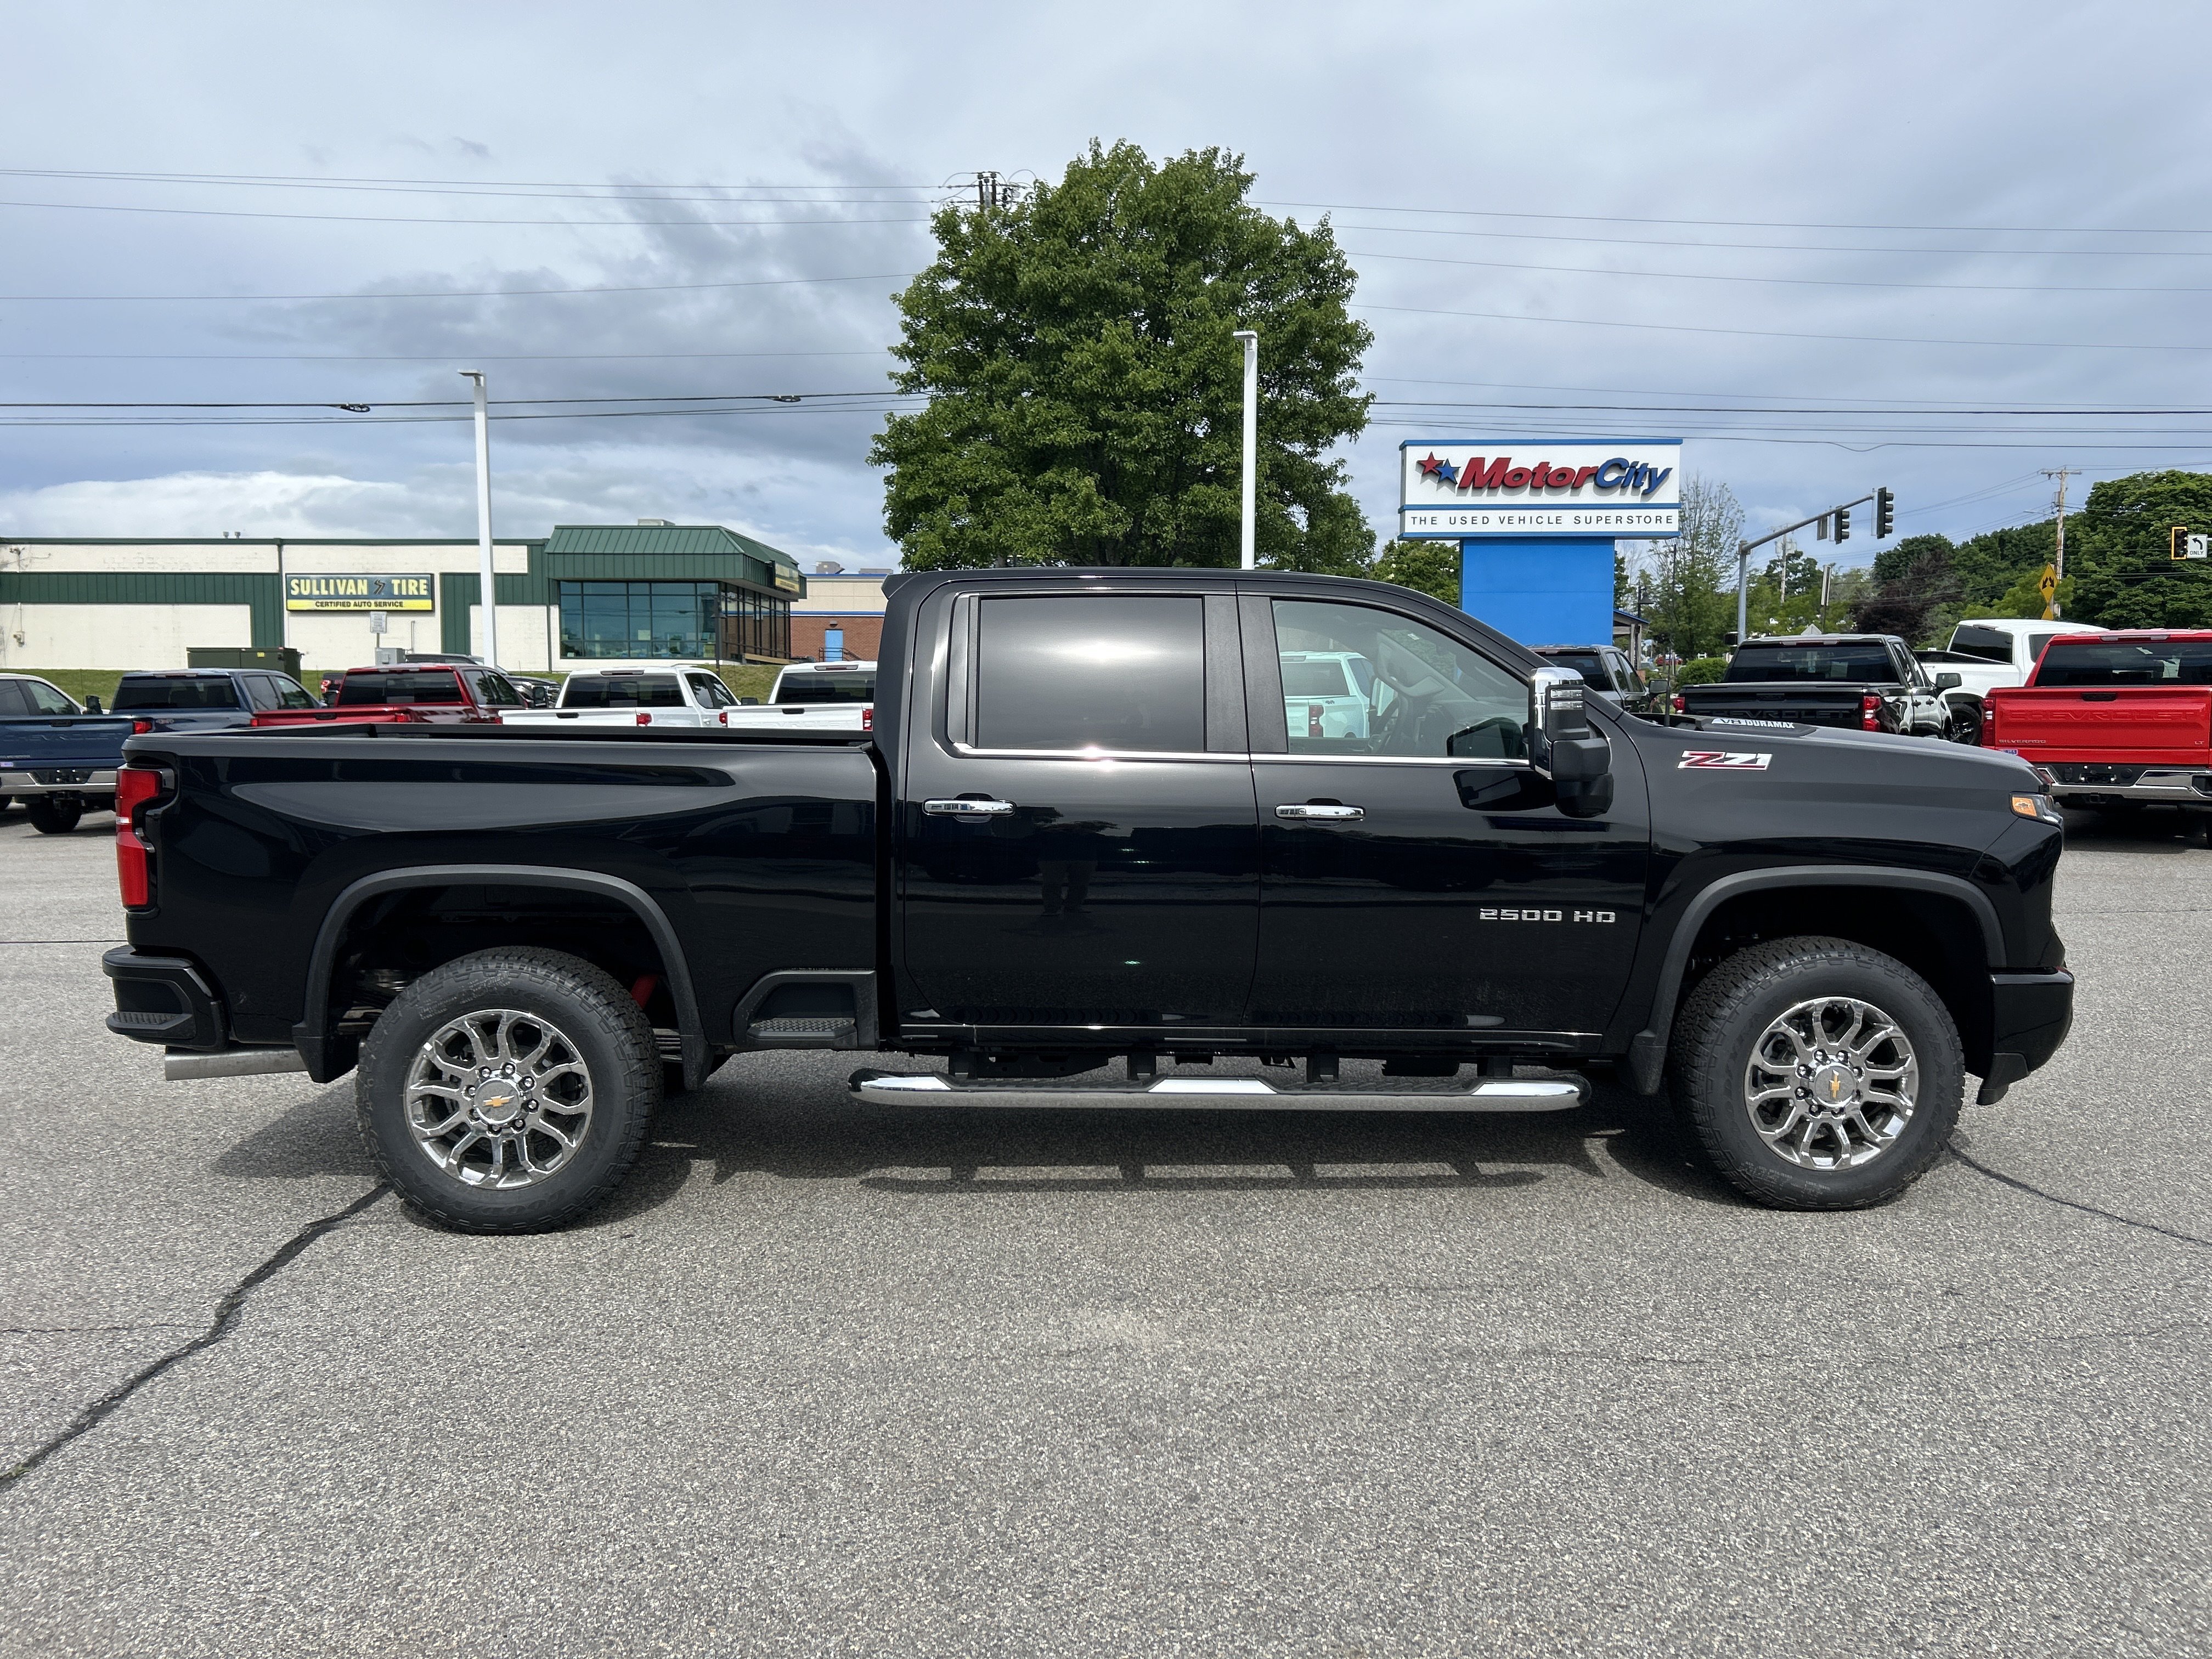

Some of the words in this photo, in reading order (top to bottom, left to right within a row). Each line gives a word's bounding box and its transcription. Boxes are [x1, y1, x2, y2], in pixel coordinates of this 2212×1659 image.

[1458, 457, 1673, 494] MotorCity
[1411, 516, 1438, 525] THE
[1449, 516, 1489, 525] USED
[1498, 516, 1563, 525] VEHICLE
[1573, 516, 1674, 524] SUPERSTORE
[290, 579, 368, 595] SULLIVAN
[391, 579, 427, 595] TIRE
[1746, 719, 1796, 729] DURAMAX
[1677, 750, 1773, 770] Z71
[1479, 908, 1563, 922] 2500
[1573, 911, 1616, 923] HD
